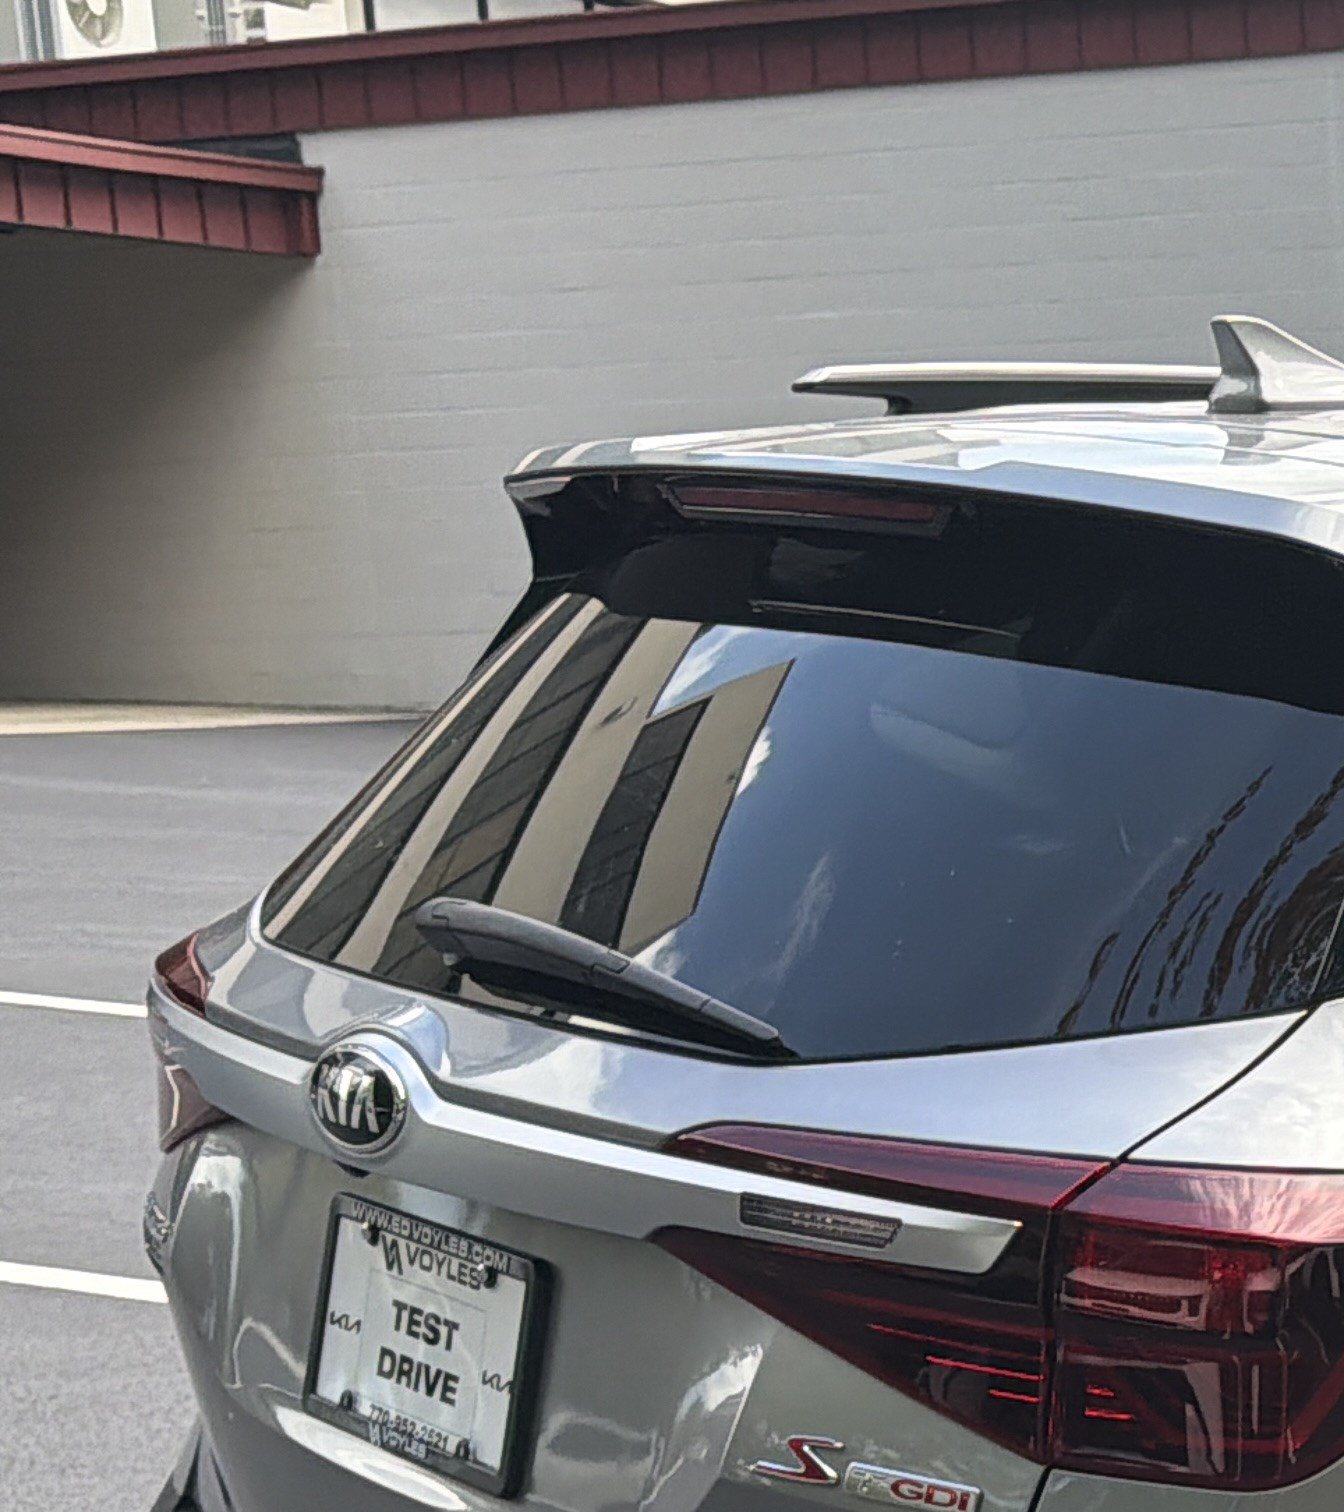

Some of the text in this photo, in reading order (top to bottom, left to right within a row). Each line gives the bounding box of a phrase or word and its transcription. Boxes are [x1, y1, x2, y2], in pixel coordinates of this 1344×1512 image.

[406, 1242, 481, 1291] VOYLES
[392, 1299, 460, 1352] TEST
[377, 1345, 460, 1407] DRIVE
